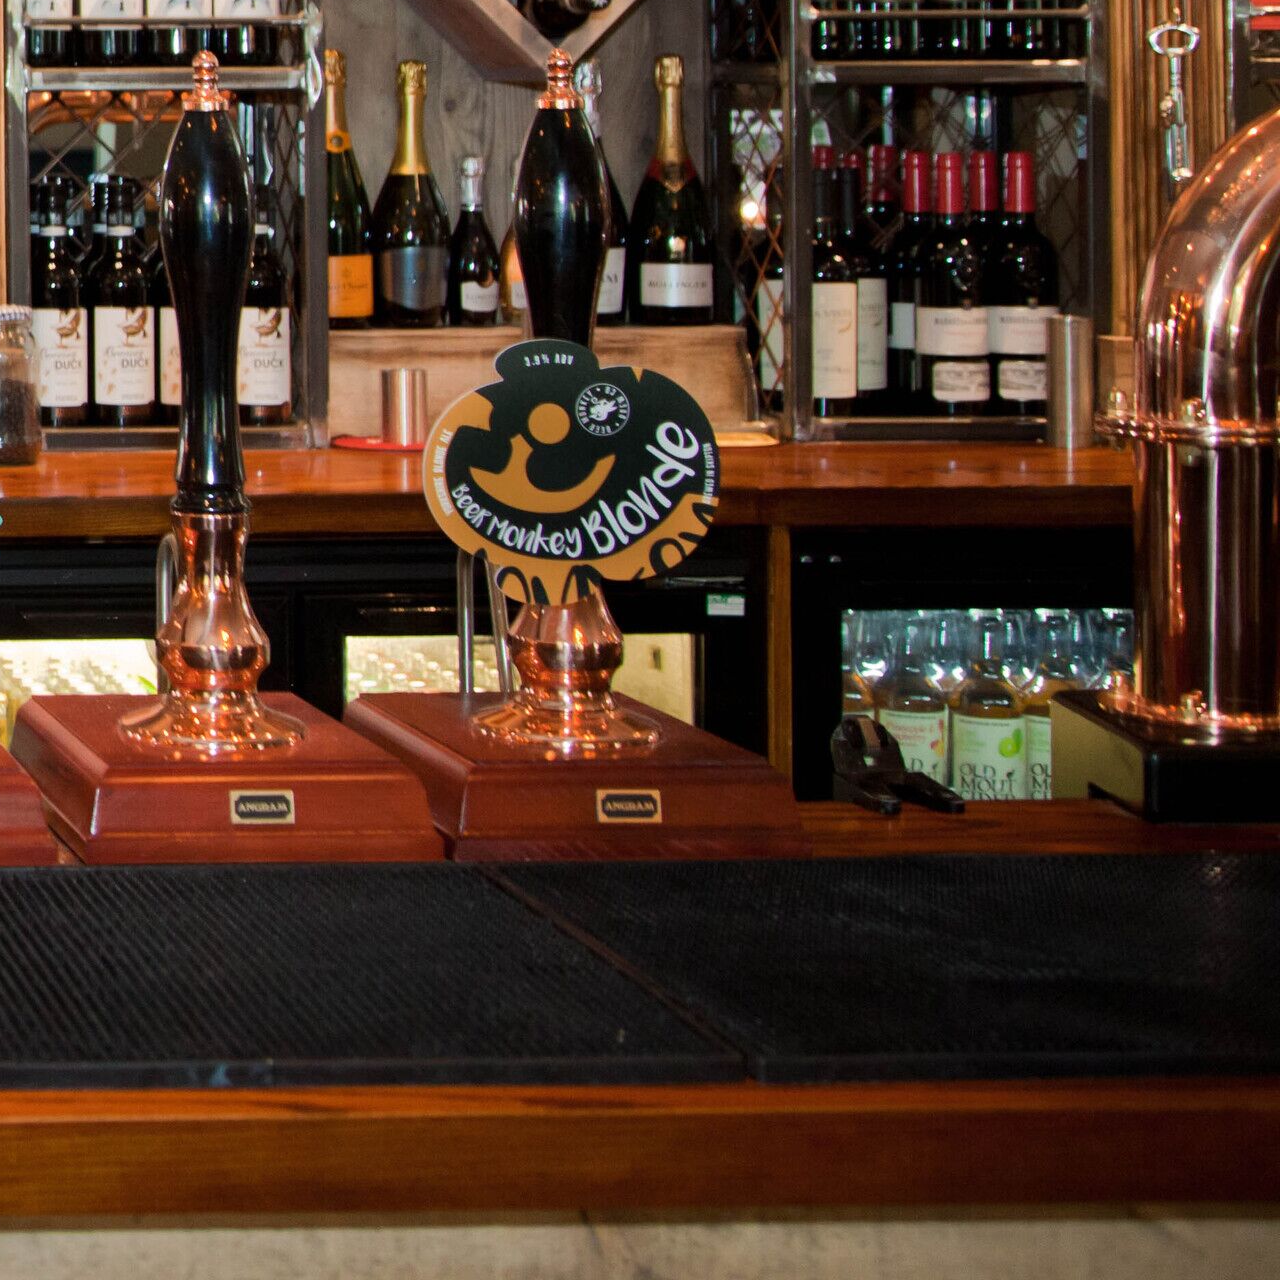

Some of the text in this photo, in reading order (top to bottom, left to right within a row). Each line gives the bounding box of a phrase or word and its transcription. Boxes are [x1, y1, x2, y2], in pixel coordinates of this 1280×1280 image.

[254, 358, 283, 369] DUCK
[555, 353, 575, 366] ABV
[580, 421, 701, 556] Blonde
[960, 763, 996, 778] OLD
[1031, 763, 1051, 777] OL
[960, 776, 1016, 792] MOUT
